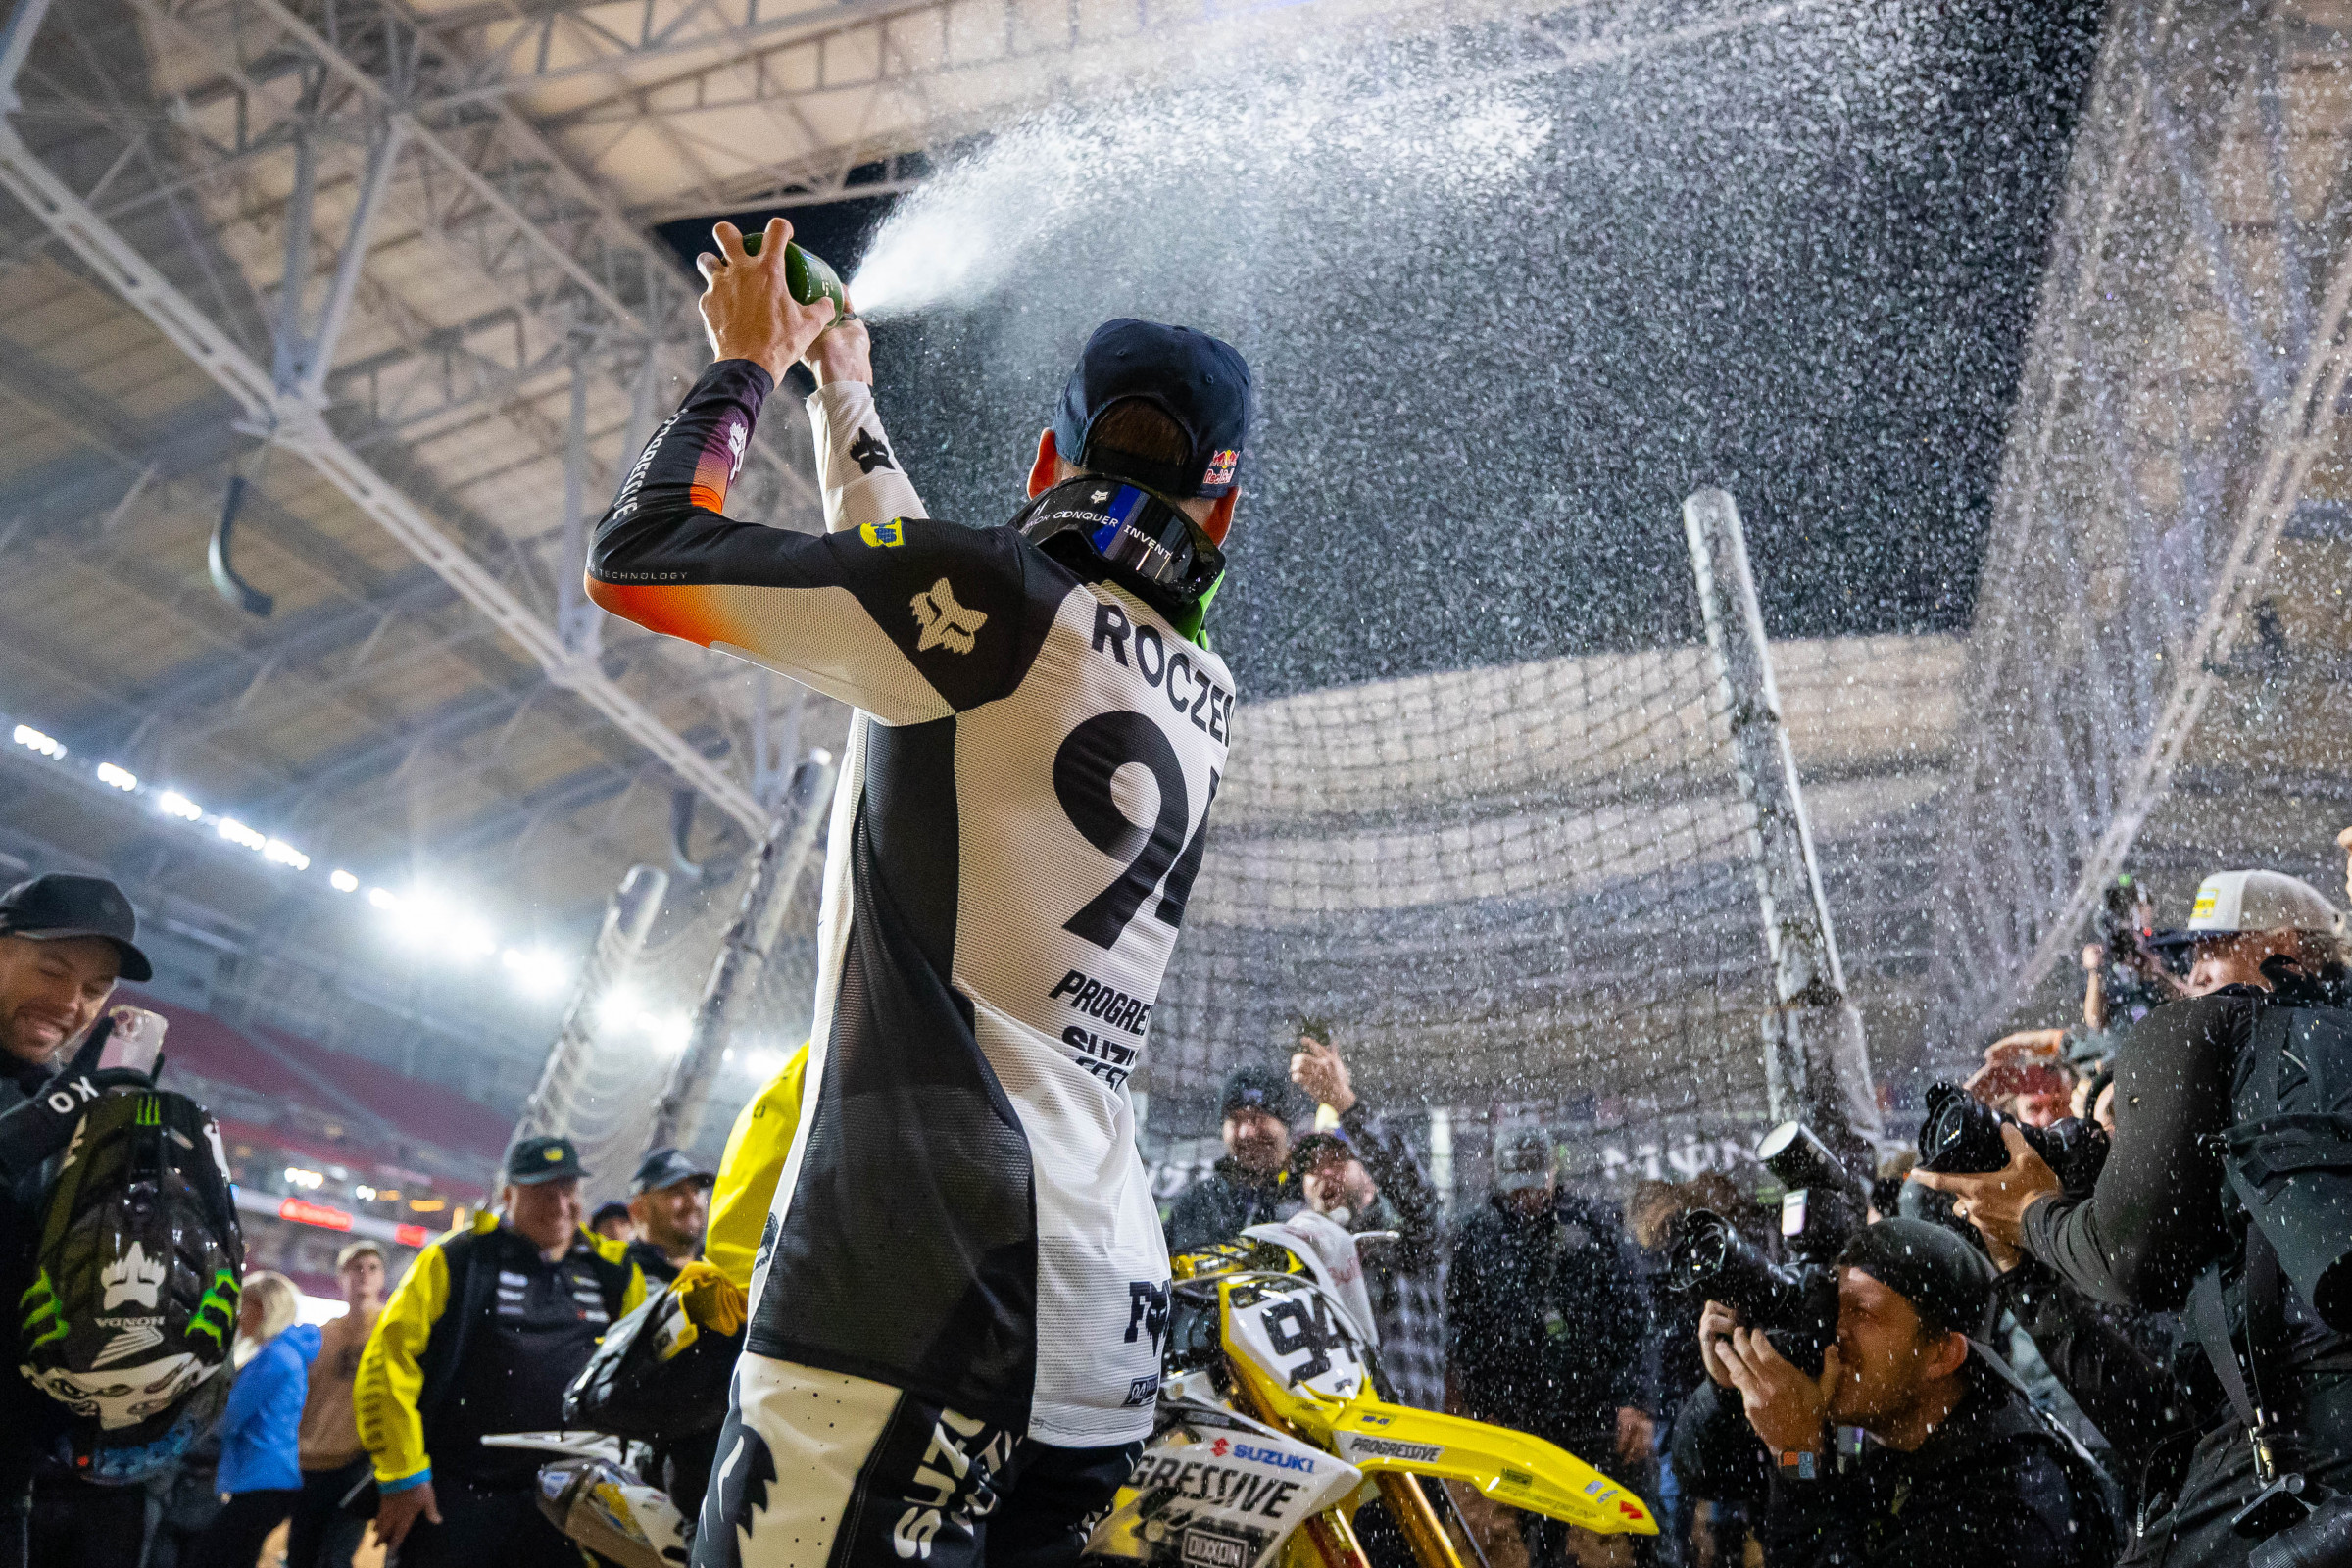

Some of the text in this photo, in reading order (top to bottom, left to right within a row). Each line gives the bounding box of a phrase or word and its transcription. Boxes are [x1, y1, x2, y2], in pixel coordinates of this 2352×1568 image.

[1053, 511, 1119, 528] CONQUER
[1124, 524, 1174, 560] INVENT
[599, 568, 688, 580] TECHNOLOGY
[1048, 968, 1153, 1036] PROGRE
[1061, 1026, 1136, 1067] SUZ
[1260, 1295, 1358, 1389] 94
[1234, 1444, 1314, 1474] SUZUKI
[1349, 1437, 1441, 1463] PROGRESSIVE
[1187, 1535, 1245, 1568] DIXXON
